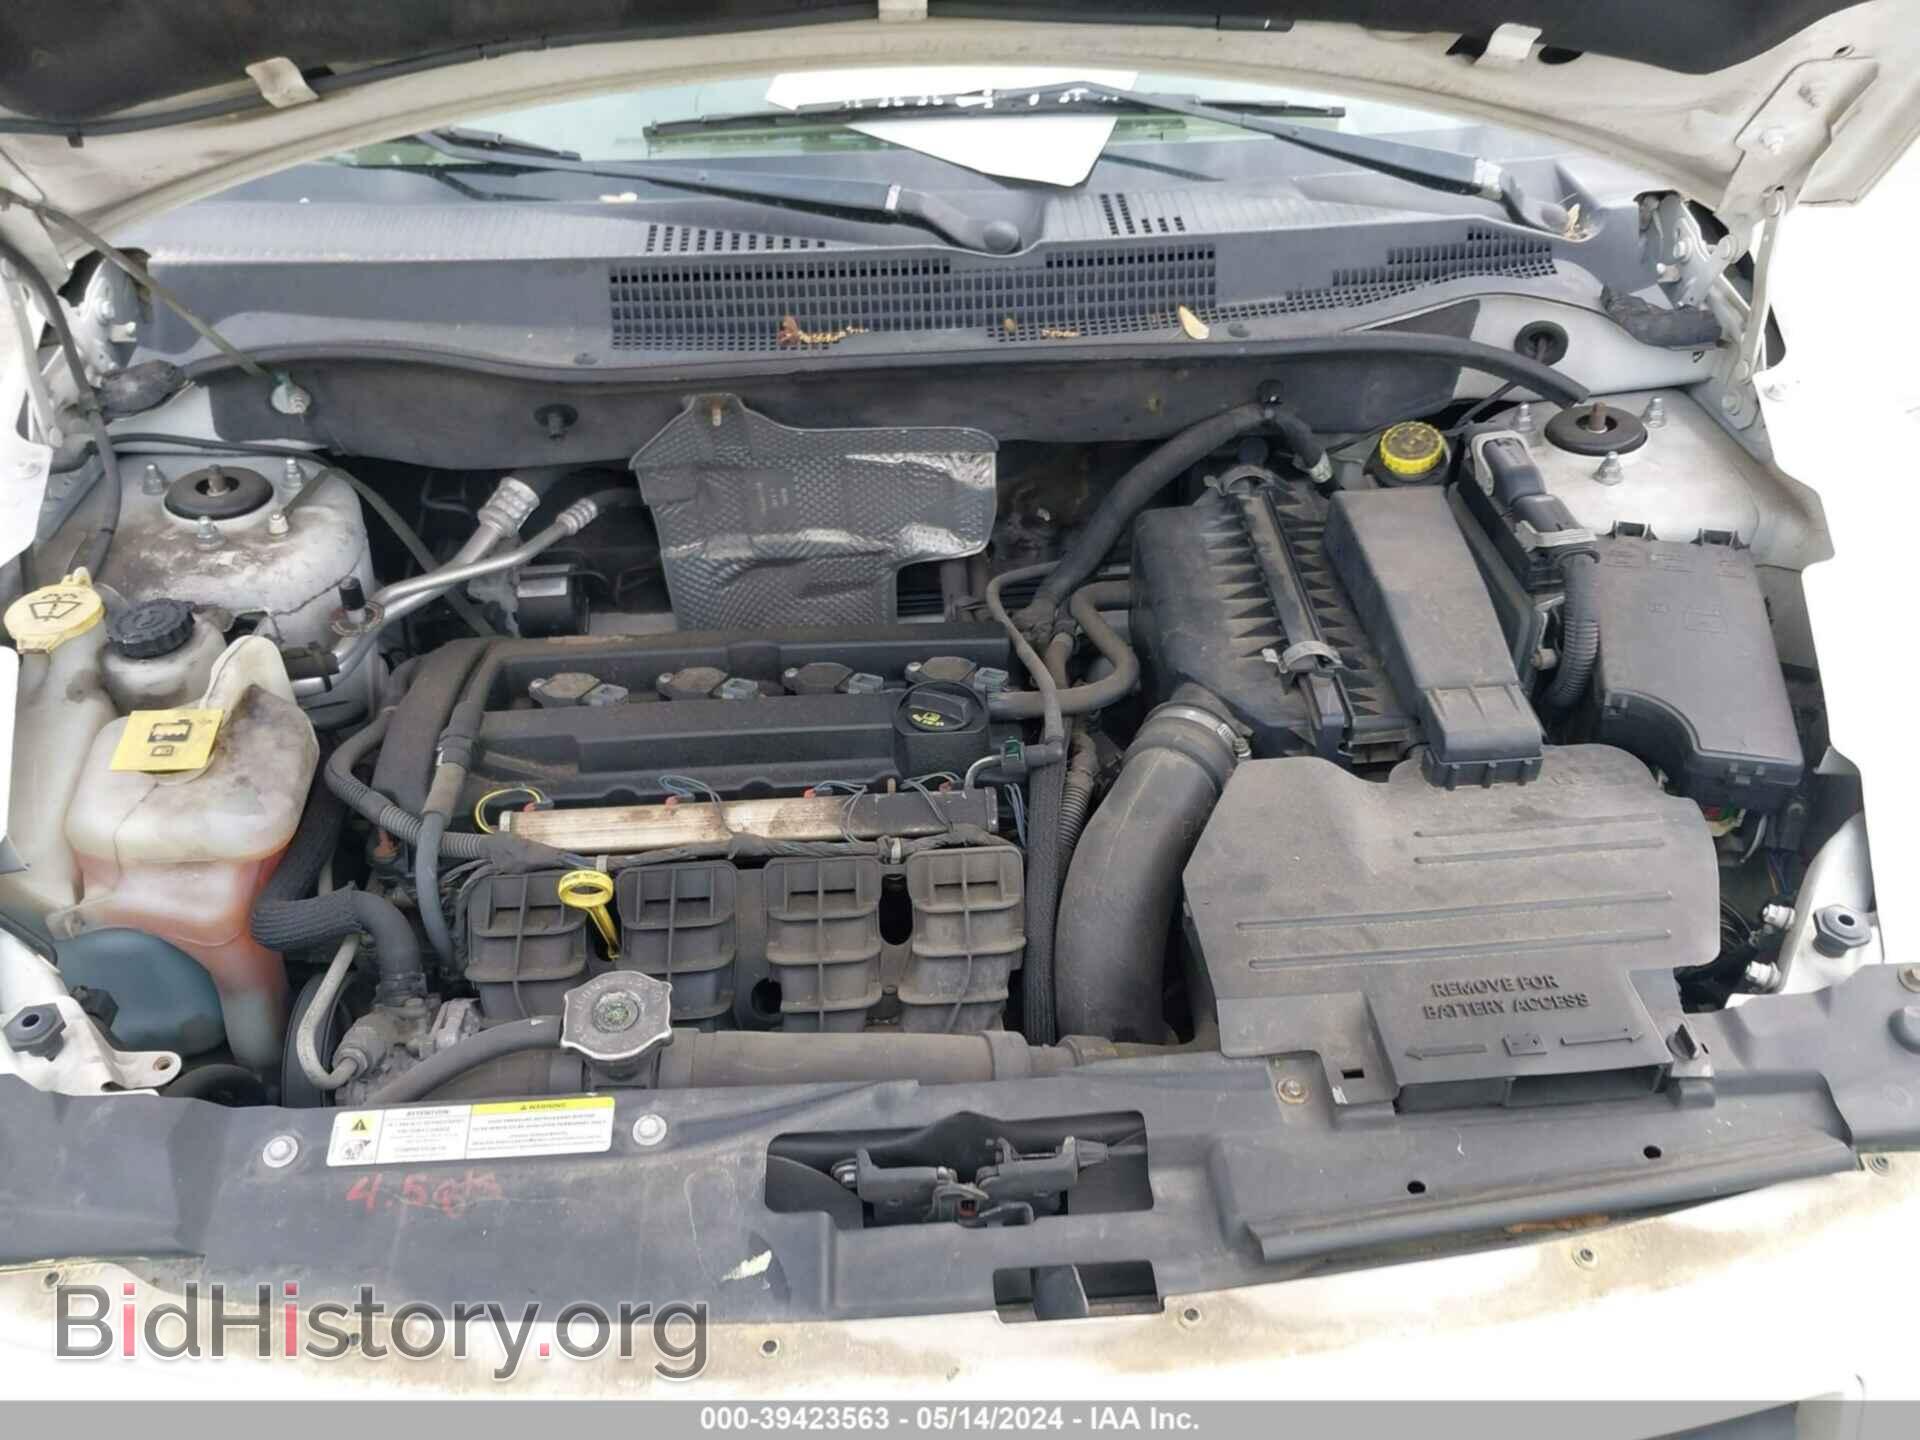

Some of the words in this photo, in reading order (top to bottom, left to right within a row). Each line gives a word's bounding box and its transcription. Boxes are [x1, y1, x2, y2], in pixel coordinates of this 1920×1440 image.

[1431, 976, 1515, 998] REMOVE
[1516, 974, 1560, 992] FOR
[1422, 998, 1505, 1020] BATTERY
[1511, 992, 1590, 1014] ACCESS
